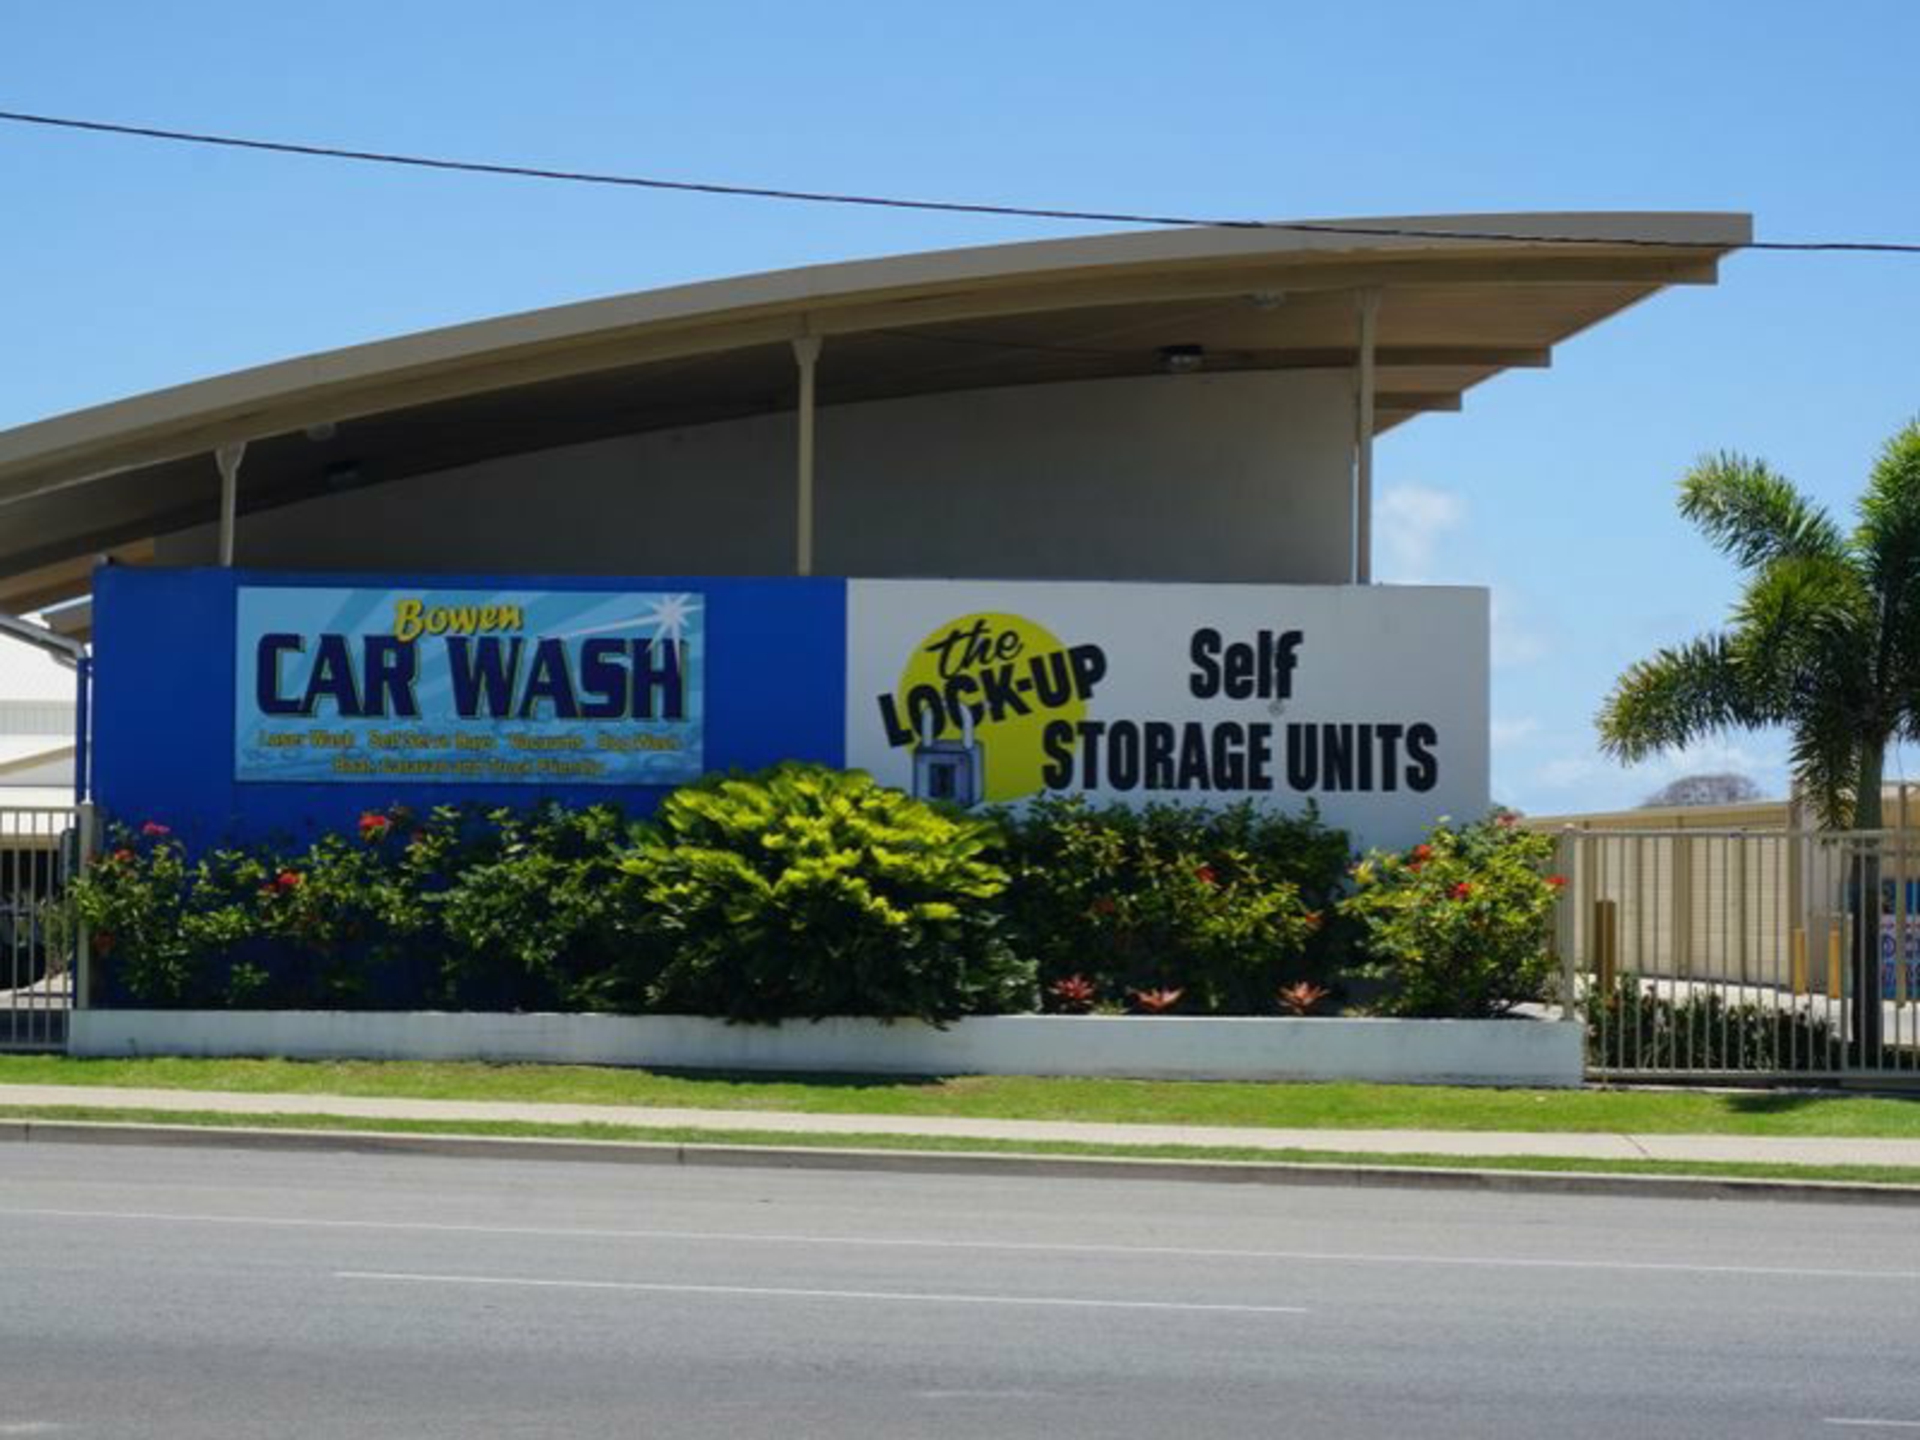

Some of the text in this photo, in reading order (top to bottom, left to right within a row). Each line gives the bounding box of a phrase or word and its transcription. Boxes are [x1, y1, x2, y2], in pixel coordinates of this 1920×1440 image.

[394, 599, 524, 642] Bowen
[925, 619, 1024, 681] the
[257, 632, 689, 721] CAR WASH
[877, 643, 1108, 749] LOCK-UP
[1189, 628, 1303, 699] Self
[1042, 719, 1439, 793] STORAGE UNITS
